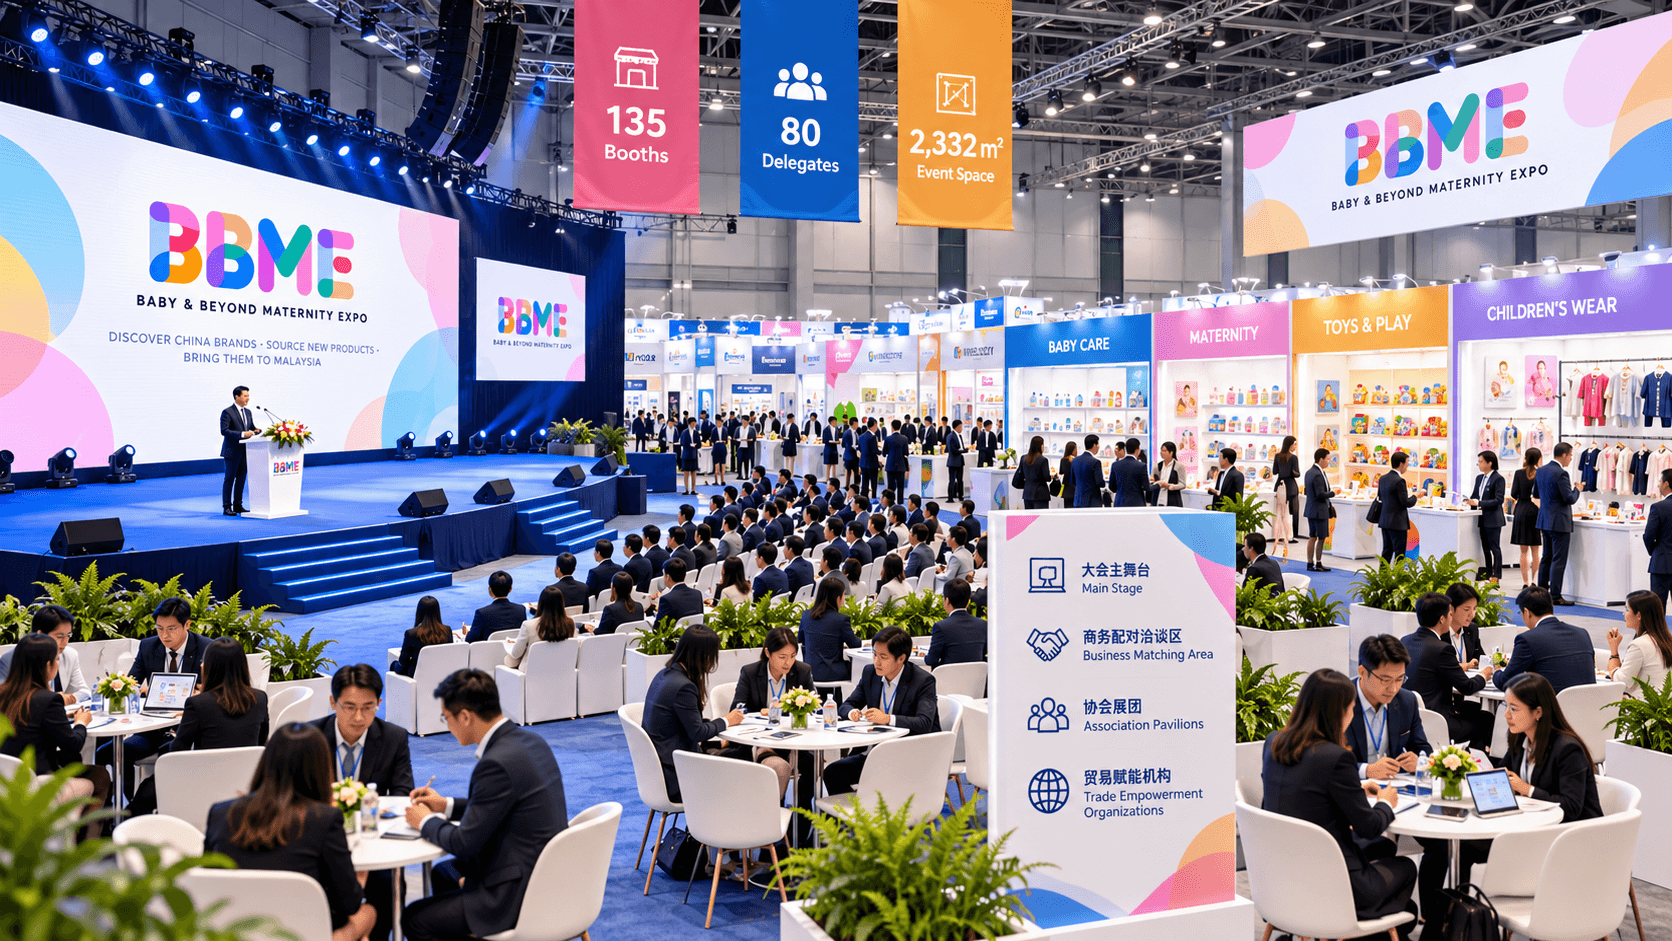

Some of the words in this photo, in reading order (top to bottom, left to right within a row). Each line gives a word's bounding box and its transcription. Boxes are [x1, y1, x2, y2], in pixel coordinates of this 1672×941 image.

[607, 106, 666, 137] 135
[781, 117, 820, 146] 80
[1344, 81, 1529, 187] BBME
[910, 129, 976, 158] 2,332
[605, 144, 668, 163] Booths
[763, 153, 839, 174] Delegates
[917, 165, 953, 180] Event
[957, 167, 994, 184] Space
[1331, 198, 1359, 212] BABY
[1363, 196, 1370, 206] &
[1375, 187, 1423, 204] BEYOND
[1430, 172, 1503, 194] MATERNITY
[1510, 164, 1548, 181] EXPO
[148, 200, 354, 300] BBME
[136, 295, 177, 309] BABY
[183, 299, 192, 311] &
[199, 300, 256, 315] BEYOND
[262, 305, 333, 321] MATERNITY
[338, 312, 367, 324] EXPO
[1572, 297, 1616, 314] WEAR
[498, 297, 567, 338] BBME
[1323, 318, 1358, 335] TOYS
[1362, 317, 1372, 333] &
[1377, 314, 1411, 331] PLAY
[108, 332, 170, 345] DISCOVER
[174, 335, 210, 347] CHINA
[214, 338, 256, 349] BRANDS
[266, 341, 304, 352] SOURCE
[307, 343, 328, 352] NEW
[330, 344, 374, 355] PRODUCTS
[1191, 326, 1258, 343] MATERNITY
[1048, 340, 1077, 354] BABY
[1079, 337, 1109, 352] CARE
[183, 353, 219, 364] BRING
[222, 354, 253, 365] THEM
[256, 356, 270, 365] TO
[273, 356, 321, 367] MALAYSIA
[1081, 562, 1150, 578] 大会主舞台
[1082, 583, 1108, 594] Main
[1111, 583, 1142, 597] Stage
[1082, 628, 1182, 645] 商务配对洽谈区
[1083, 650, 1130, 661] Business
[1133, 649, 1184, 663] Matching
[1187, 649, 1213, 660] Area
[1082, 699, 1141, 716] 协会展团
[1083, 720, 1149, 732] Association
[1153, 719, 1204, 730] Pavilions
[1084, 768, 1171, 786] 贸易赋能机构
[1083, 791, 1116, 803] Trade
[1119, 789, 1203, 804] Empowerment
[1083, 805, 1164, 821] Organizations
